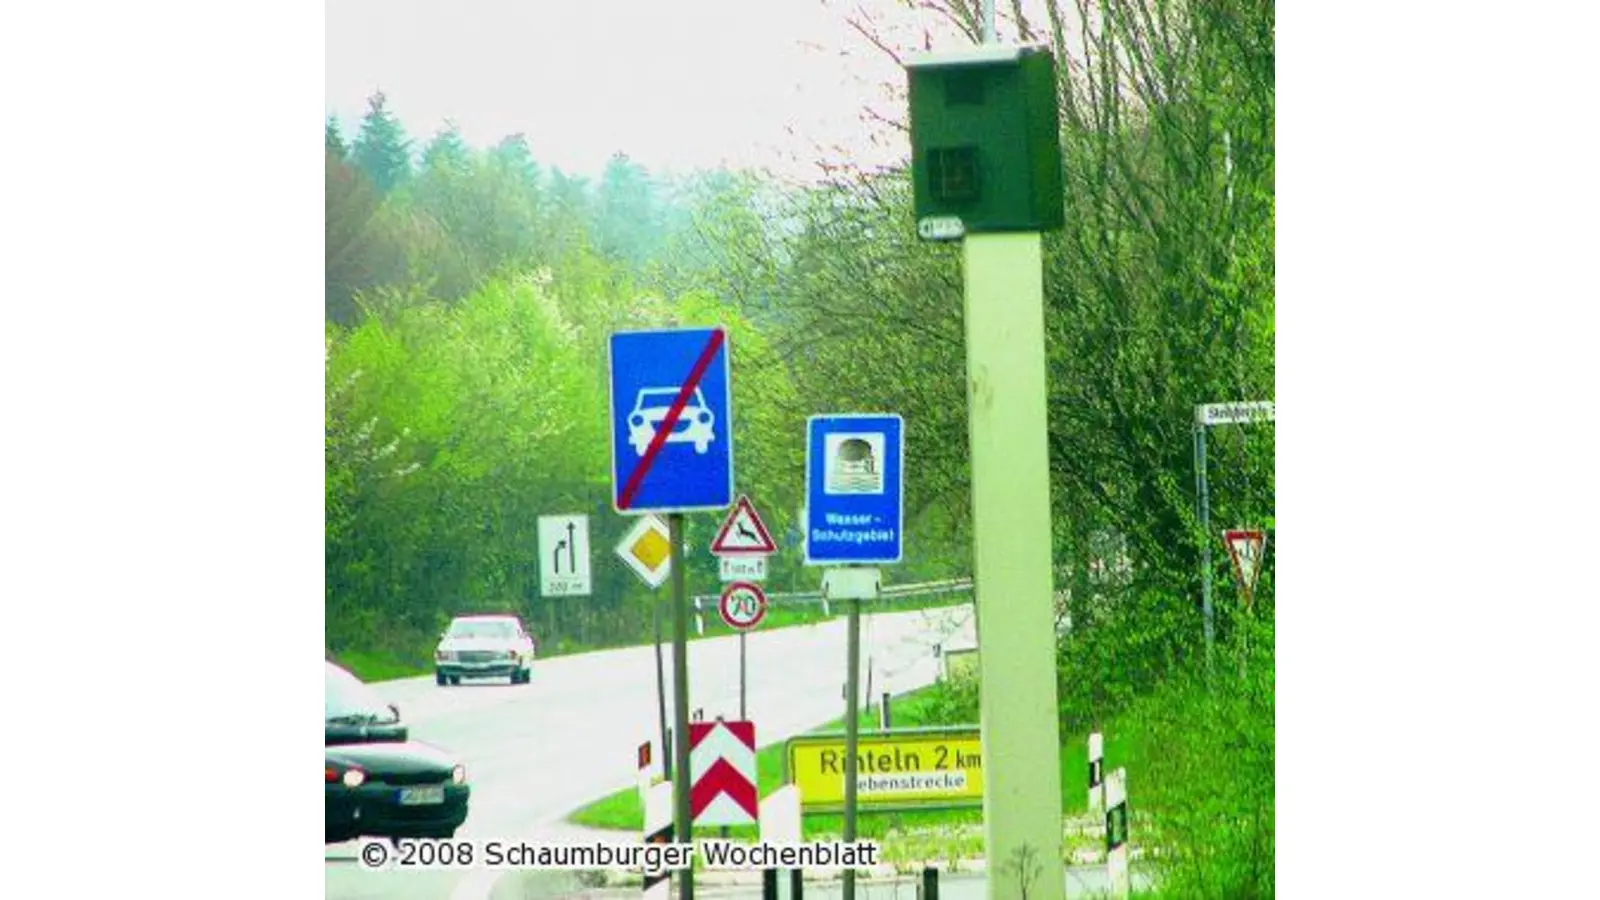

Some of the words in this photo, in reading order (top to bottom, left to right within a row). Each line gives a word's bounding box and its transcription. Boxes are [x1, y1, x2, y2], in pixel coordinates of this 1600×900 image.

[825, 512, 872, 526] Wasser
[811, 527, 895, 544] Schutzgebiet
[730, 594, 756, 617] 70
[819, 746, 920, 775] Rinteln
[934, 744, 949, 770] 2
[955, 749, 981, 769] km
[856, 773, 965, 792] ebenstrecke
